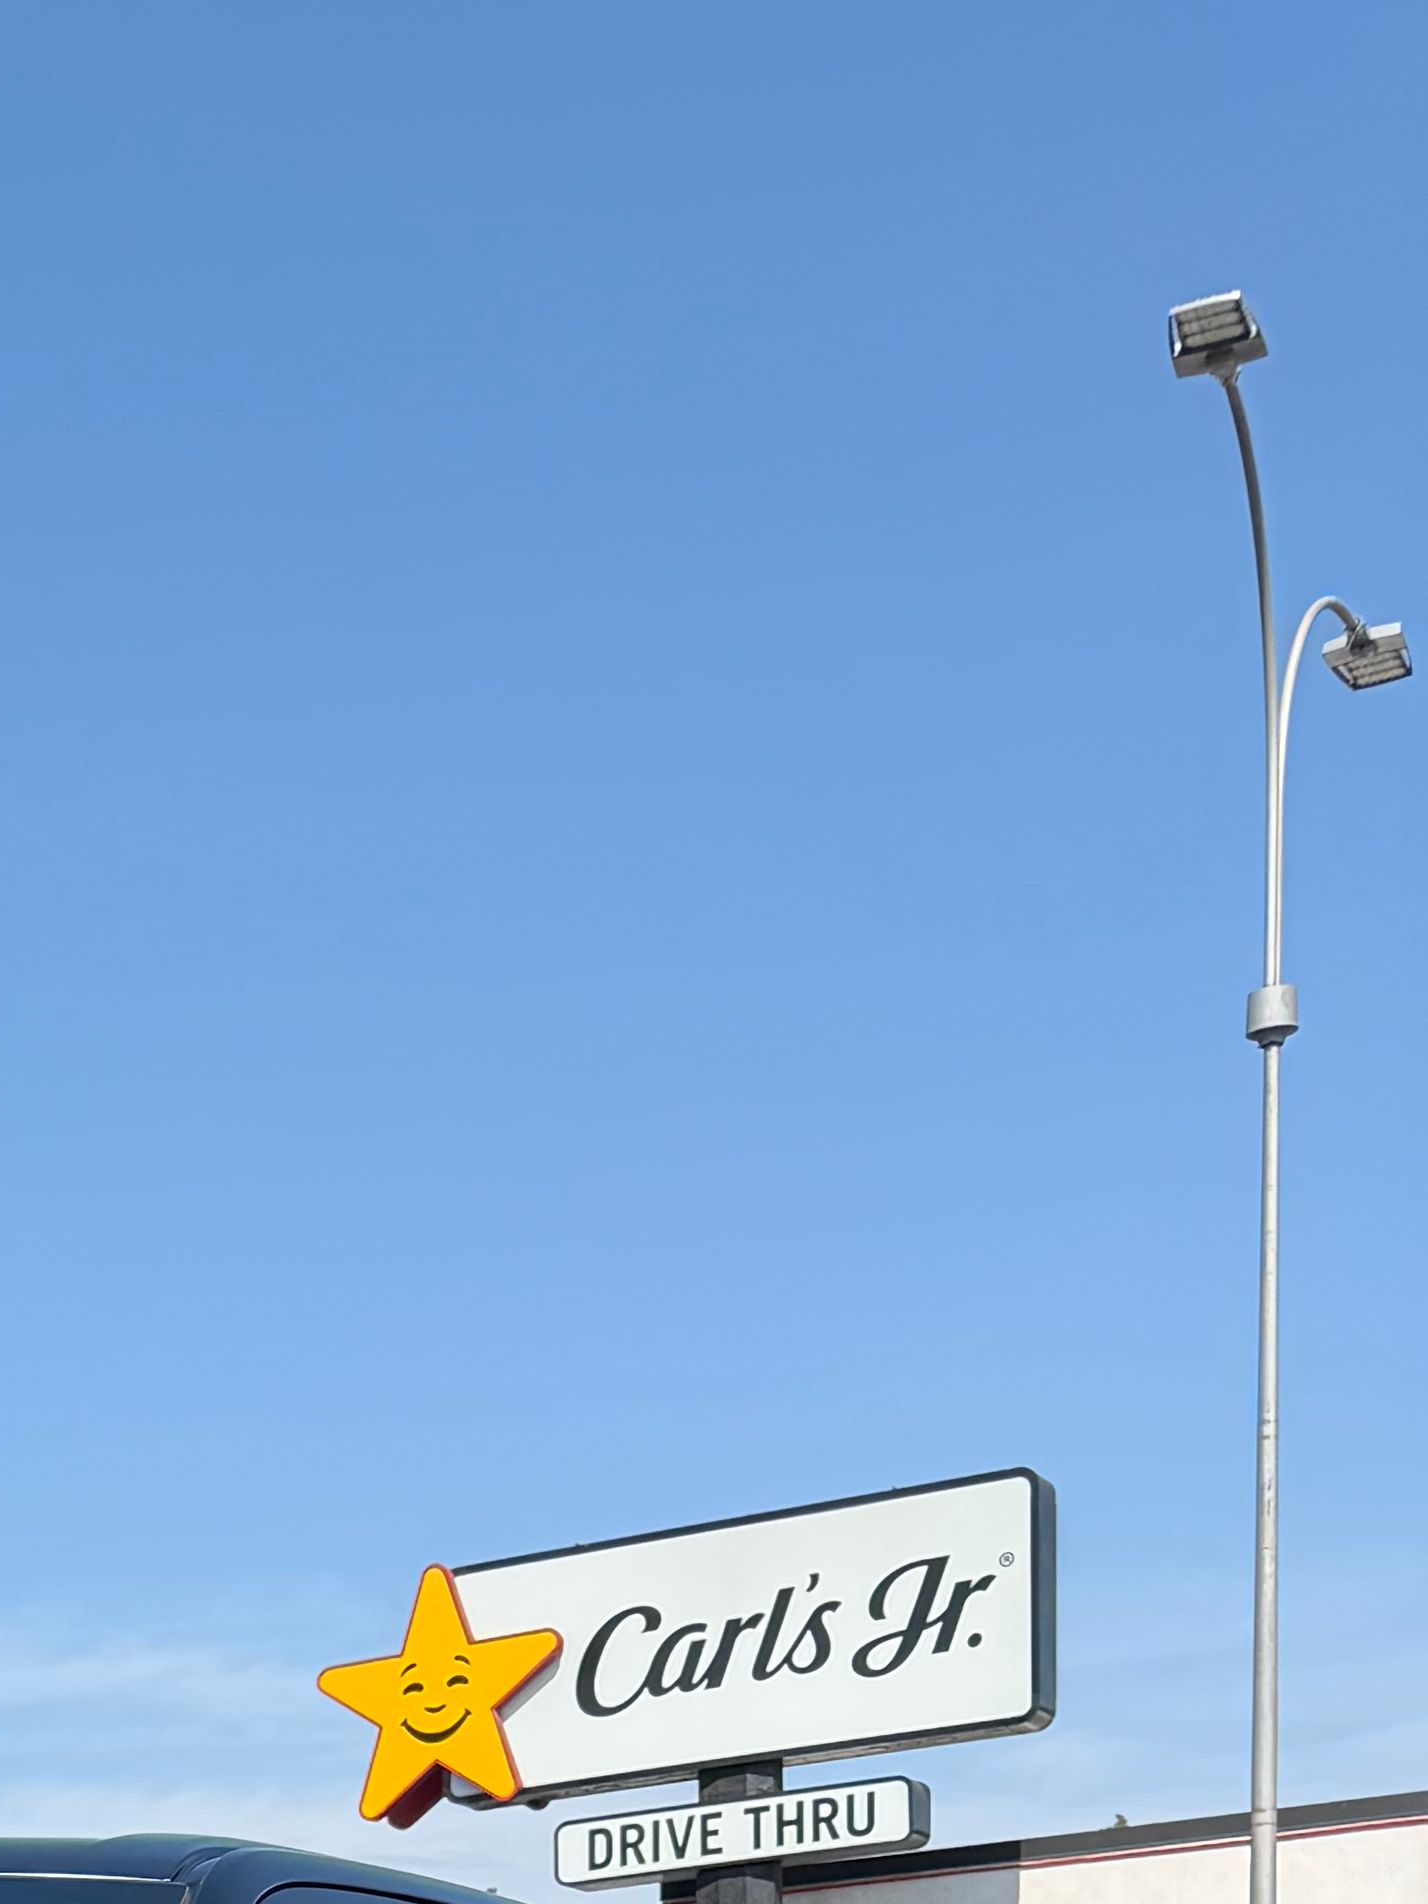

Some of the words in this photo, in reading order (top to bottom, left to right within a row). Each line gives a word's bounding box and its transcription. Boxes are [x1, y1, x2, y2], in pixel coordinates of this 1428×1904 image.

[574, 1572, 843, 1718] Carl's
[851, 1554, 998, 1679] Jr.
[587, 1811, 723, 1871] DRIVE
[744, 1790, 878, 1851] THRU
